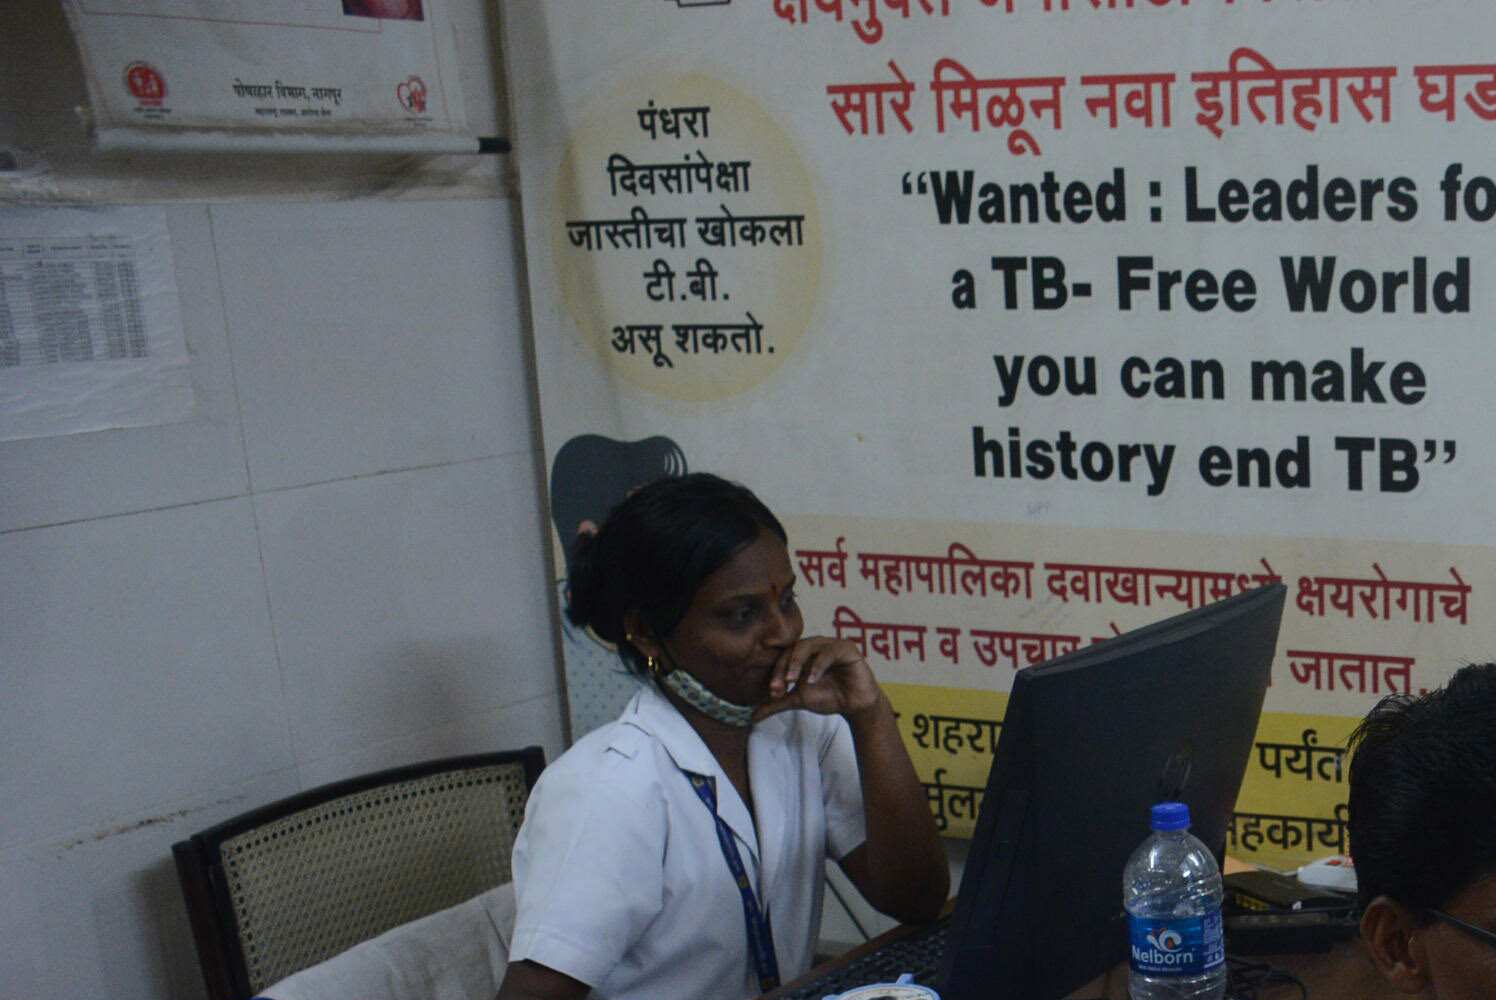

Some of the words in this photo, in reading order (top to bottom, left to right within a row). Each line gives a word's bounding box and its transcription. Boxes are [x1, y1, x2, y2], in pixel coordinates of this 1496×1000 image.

[637, 99, 711, 140] पंधरा
[827, 61, 916, 136] सारे
[928, 57, 1068, 157] मिळून
[1081, 72, 1177, 129] नवा
[1190, 47, 1398, 139] इतिहास
[606, 150, 752, 197] दिवसांपेक्षा
[1184, 164, 1418, 223] Leaders
[565, 206, 687, 252] जास्तीचा
[695, 203, 805, 247] खोकला
[951, 268, 977, 310] a
[991, 256, 1092, 310] TB-
[1117, 255, 1257, 313] Free
[1279, 255, 1471, 314] World
[611, 324, 673, 368] असू
[993, 354, 1097, 408] you
[1120, 356, 1225, 400] can
[1251, 347, 1427, 405] make
[972, 425, 1177, 497] history
[1198, 435, 1311, 489] end
[796, 536, 848, 588] सर्व
[858, 542, 1034, 598] महापालिका
[1295, 563, 1472, 625] क्षयरोगाचे
[936, 626, 961, 664] व
